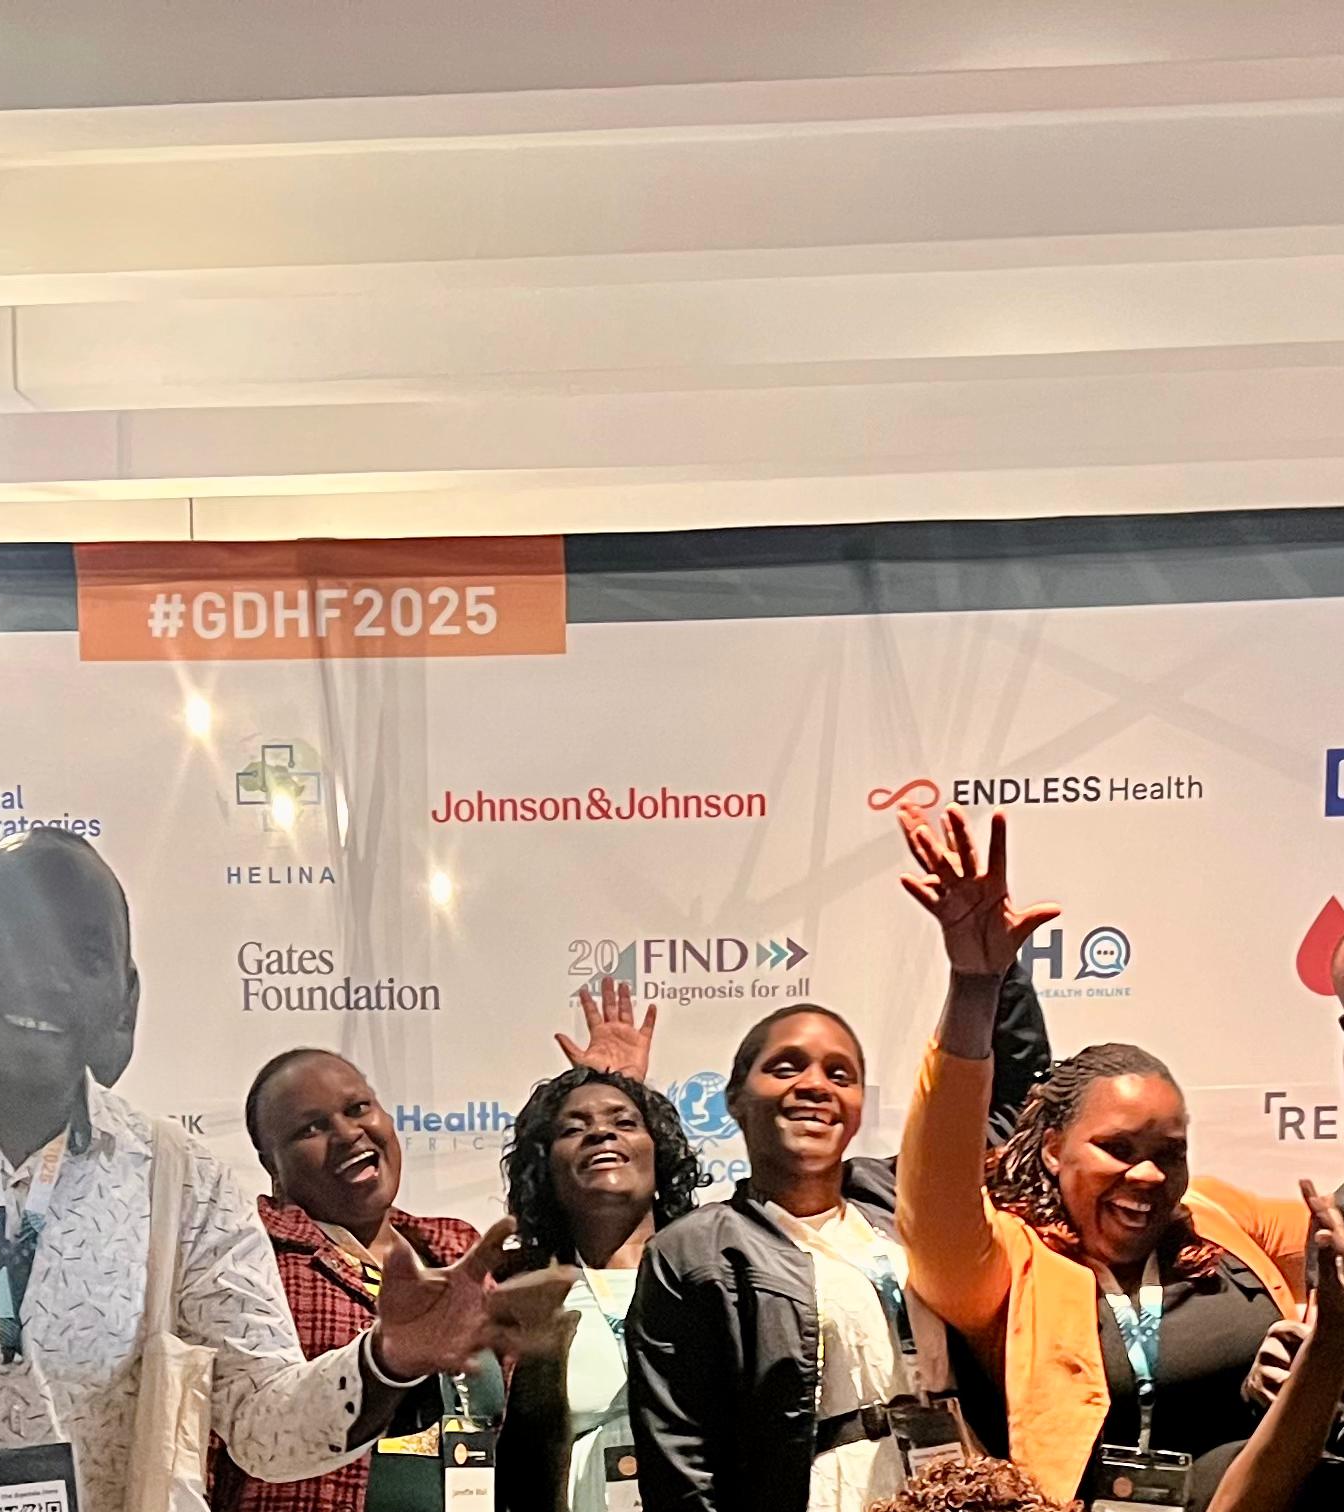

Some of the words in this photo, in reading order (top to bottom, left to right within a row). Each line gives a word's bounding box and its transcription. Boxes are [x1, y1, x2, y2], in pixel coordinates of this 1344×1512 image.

[148, 586, 497, 640] #GDHF2025
[431, 787, 766, 823] Johnson&Johnson
[953, 776, 1101, 805] ENDLESS
[1110, 775, 1203, 801] Health
[227, 867, 335, 884] HELINA
[237, 941, 334, 976] Gates
[644, 938, 749, 973] FIND
[241, 976, 440, 1011] Foundation
[644, 980, 744, 1006] Diagnosis
[751, 978, 779, 998] for
[786, 978, 810, 997] all
[397, 1102, 514, 1132] Health
